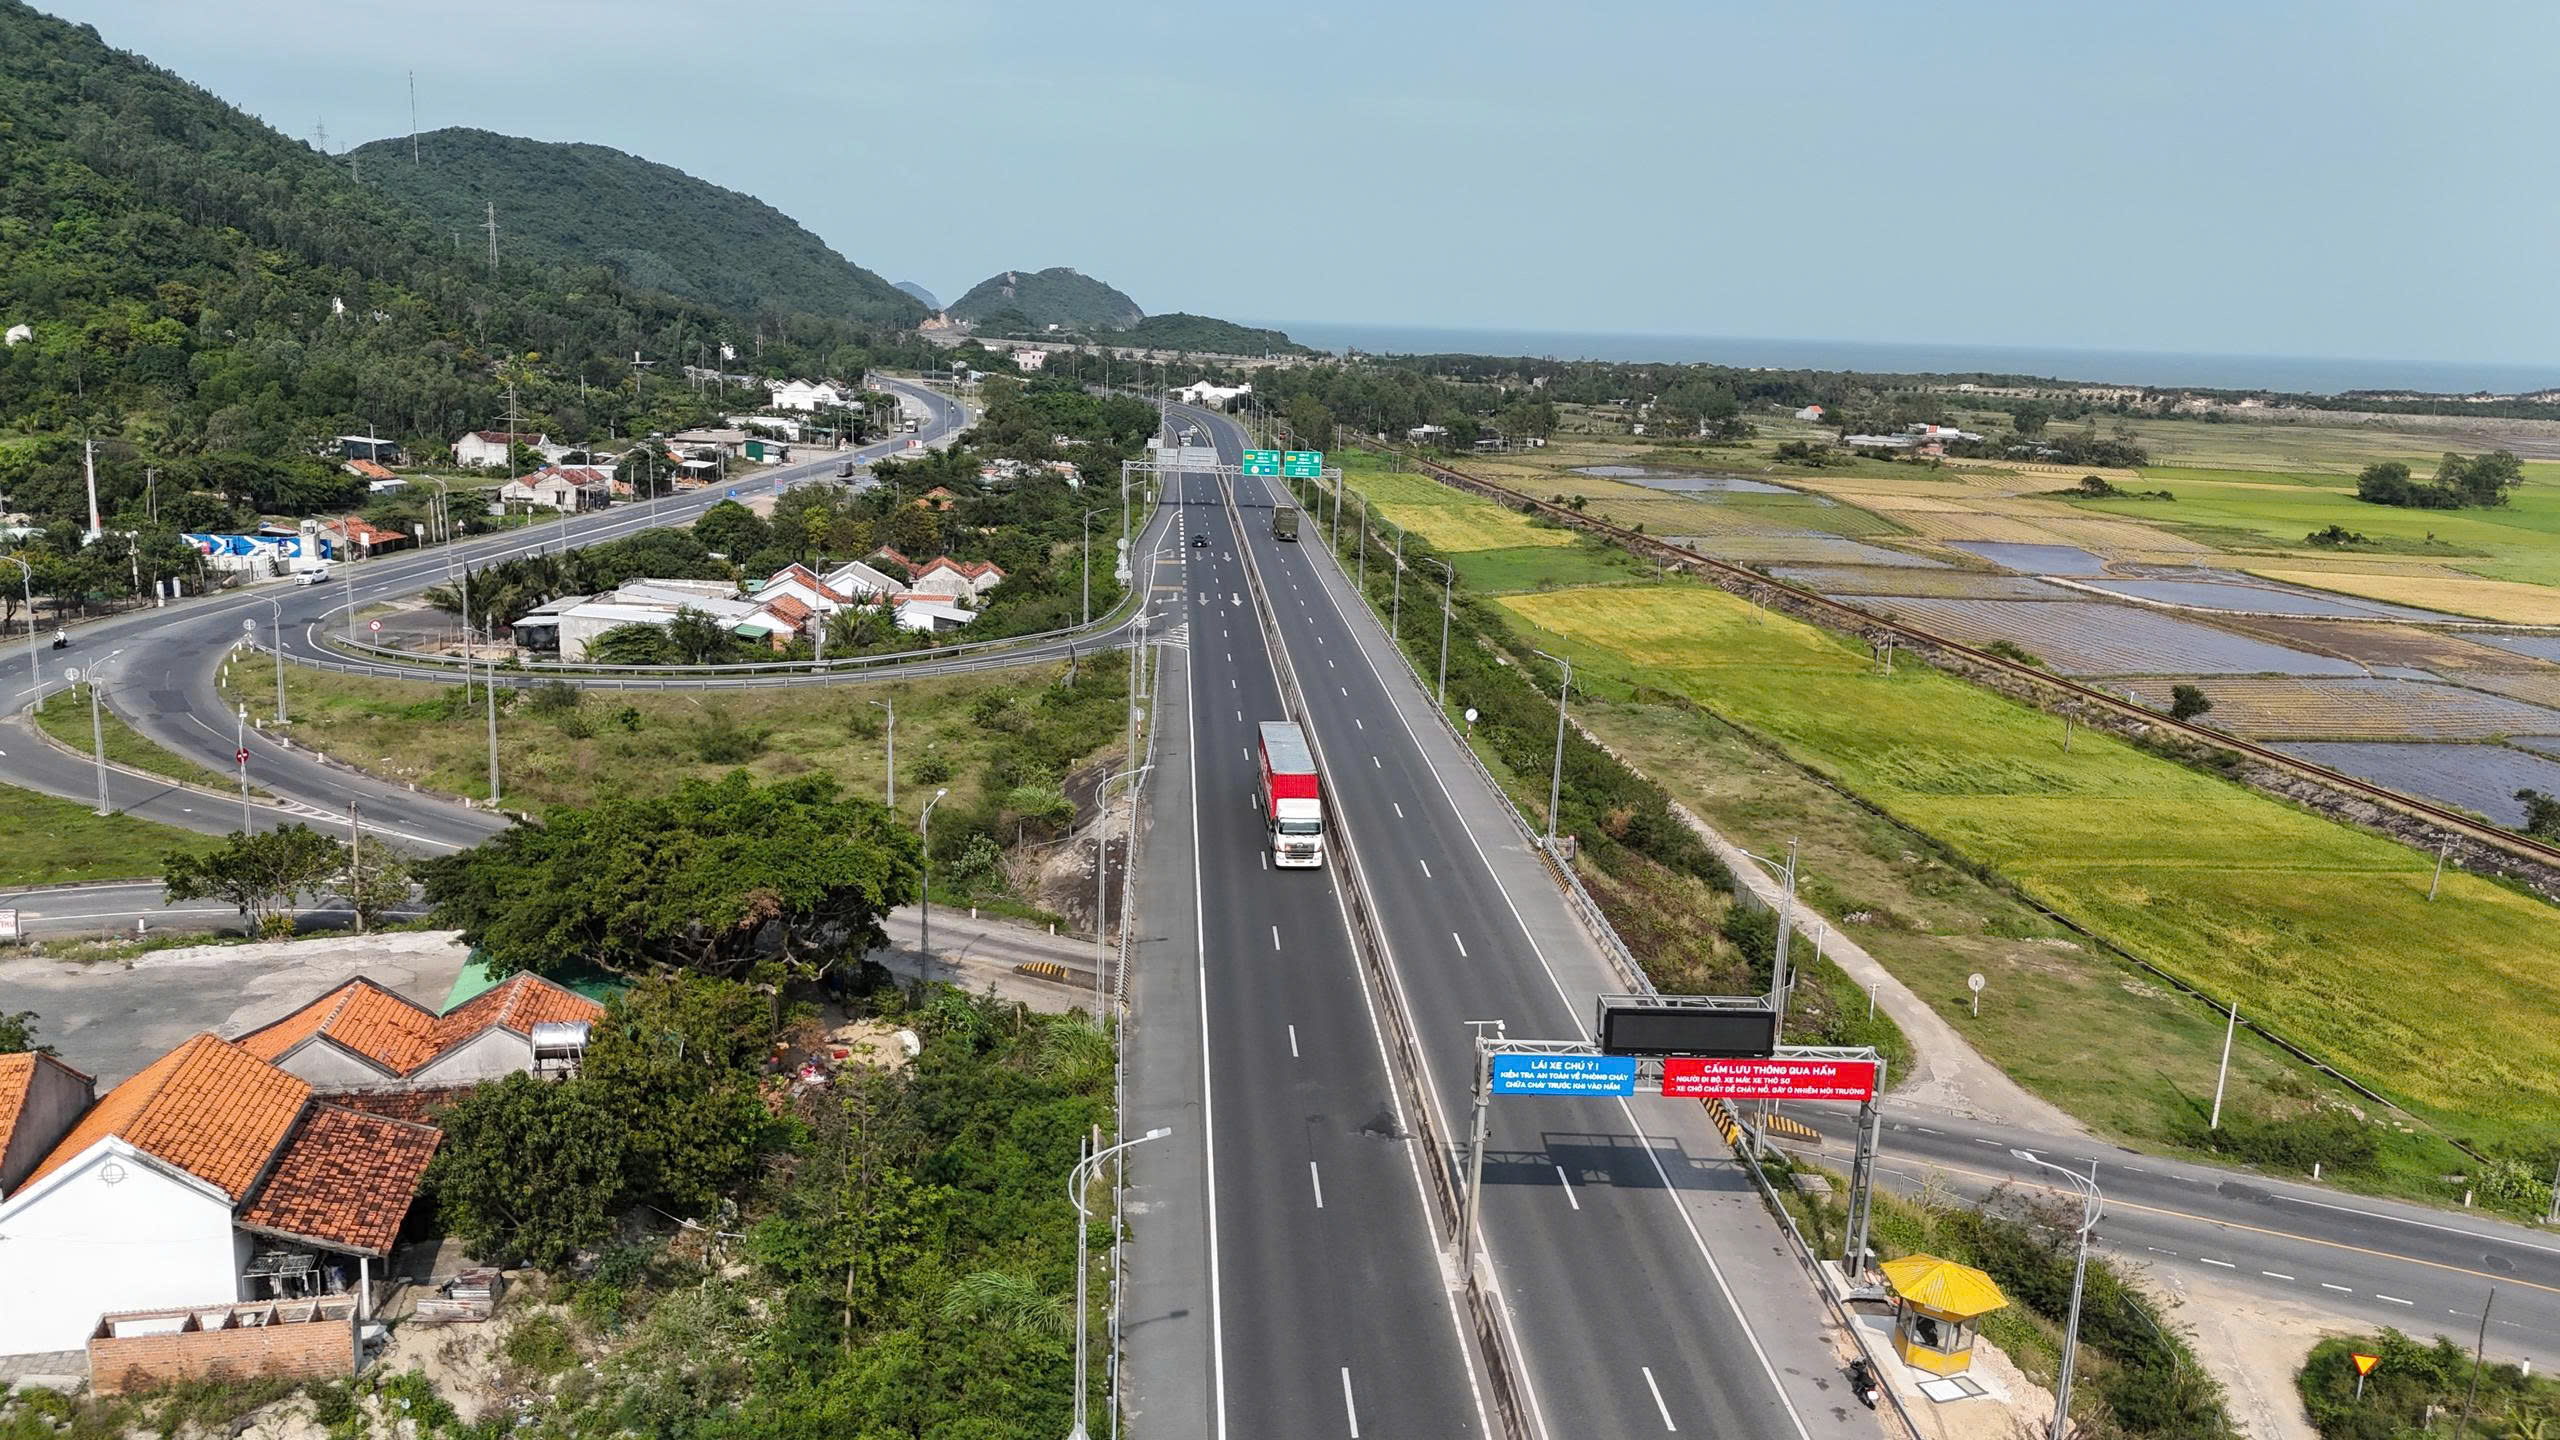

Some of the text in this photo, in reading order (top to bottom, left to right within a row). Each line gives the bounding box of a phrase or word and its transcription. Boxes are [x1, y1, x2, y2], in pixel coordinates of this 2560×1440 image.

[1531, 1060, 1548, 1070] LÁI
[1550, 1061, 1563, 1070] XE
[1564, 1060, 1585, 1070] CHÚ
[1587, 1060, 1594, 1070] Ý
[1704, 1062, 1837, 1076] CẤM LƯU THÔNG QUA HẦM
[1547, 1081, 1572, 1089] TRƯỚC
[1587, 1082, 1602, 1090] VÀO
[1835, 1087, 1865, 1095] TRƯỜNG
